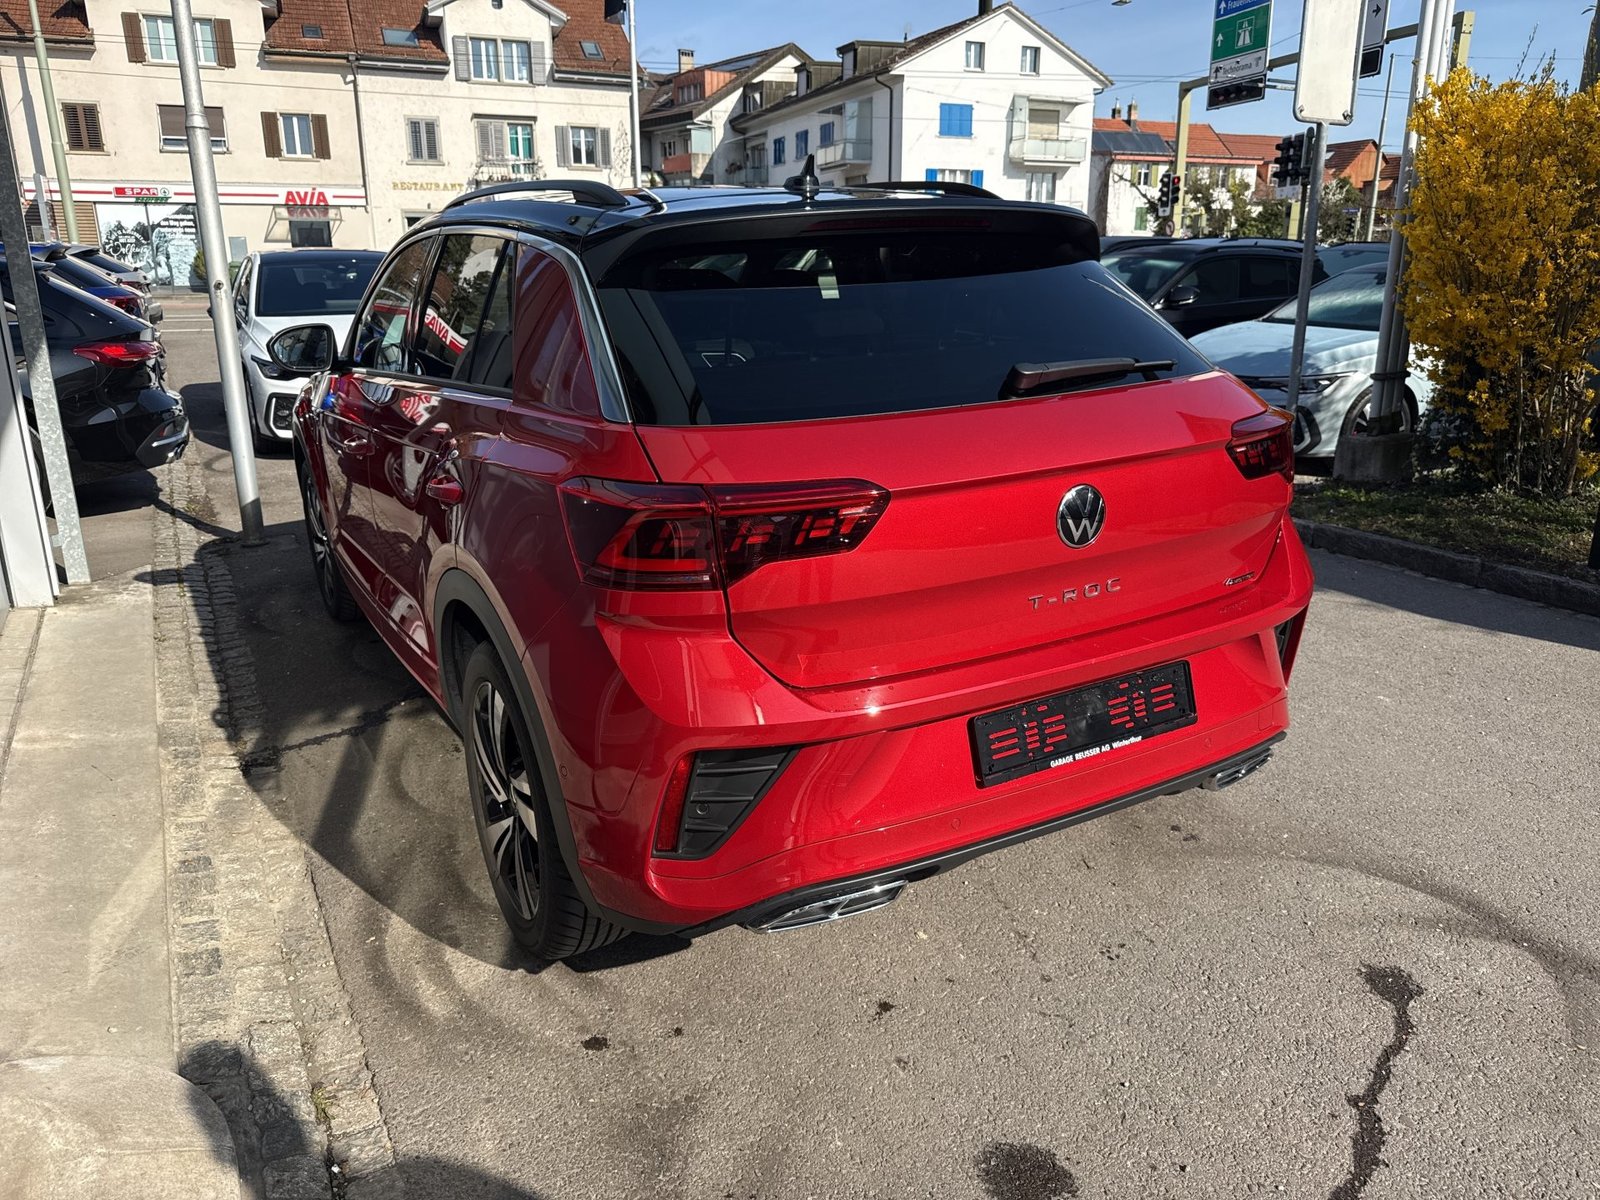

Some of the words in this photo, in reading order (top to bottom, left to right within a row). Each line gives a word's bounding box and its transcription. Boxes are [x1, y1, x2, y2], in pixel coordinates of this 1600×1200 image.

[1223, 62, 1252, 75] Technorama
[124, 187, 158, 195] SPAR
[391, 181, 465, 192] RESTAURANT
[1028, 578, 1121, 610] T-ROC
[1050, 755, 1074, 768] GARAGE
[1074, 747, 1100, 760] REUSSER
[1101, 744, 1110, 752] AG
[1112, 735, 1142, 749] Winterthur
